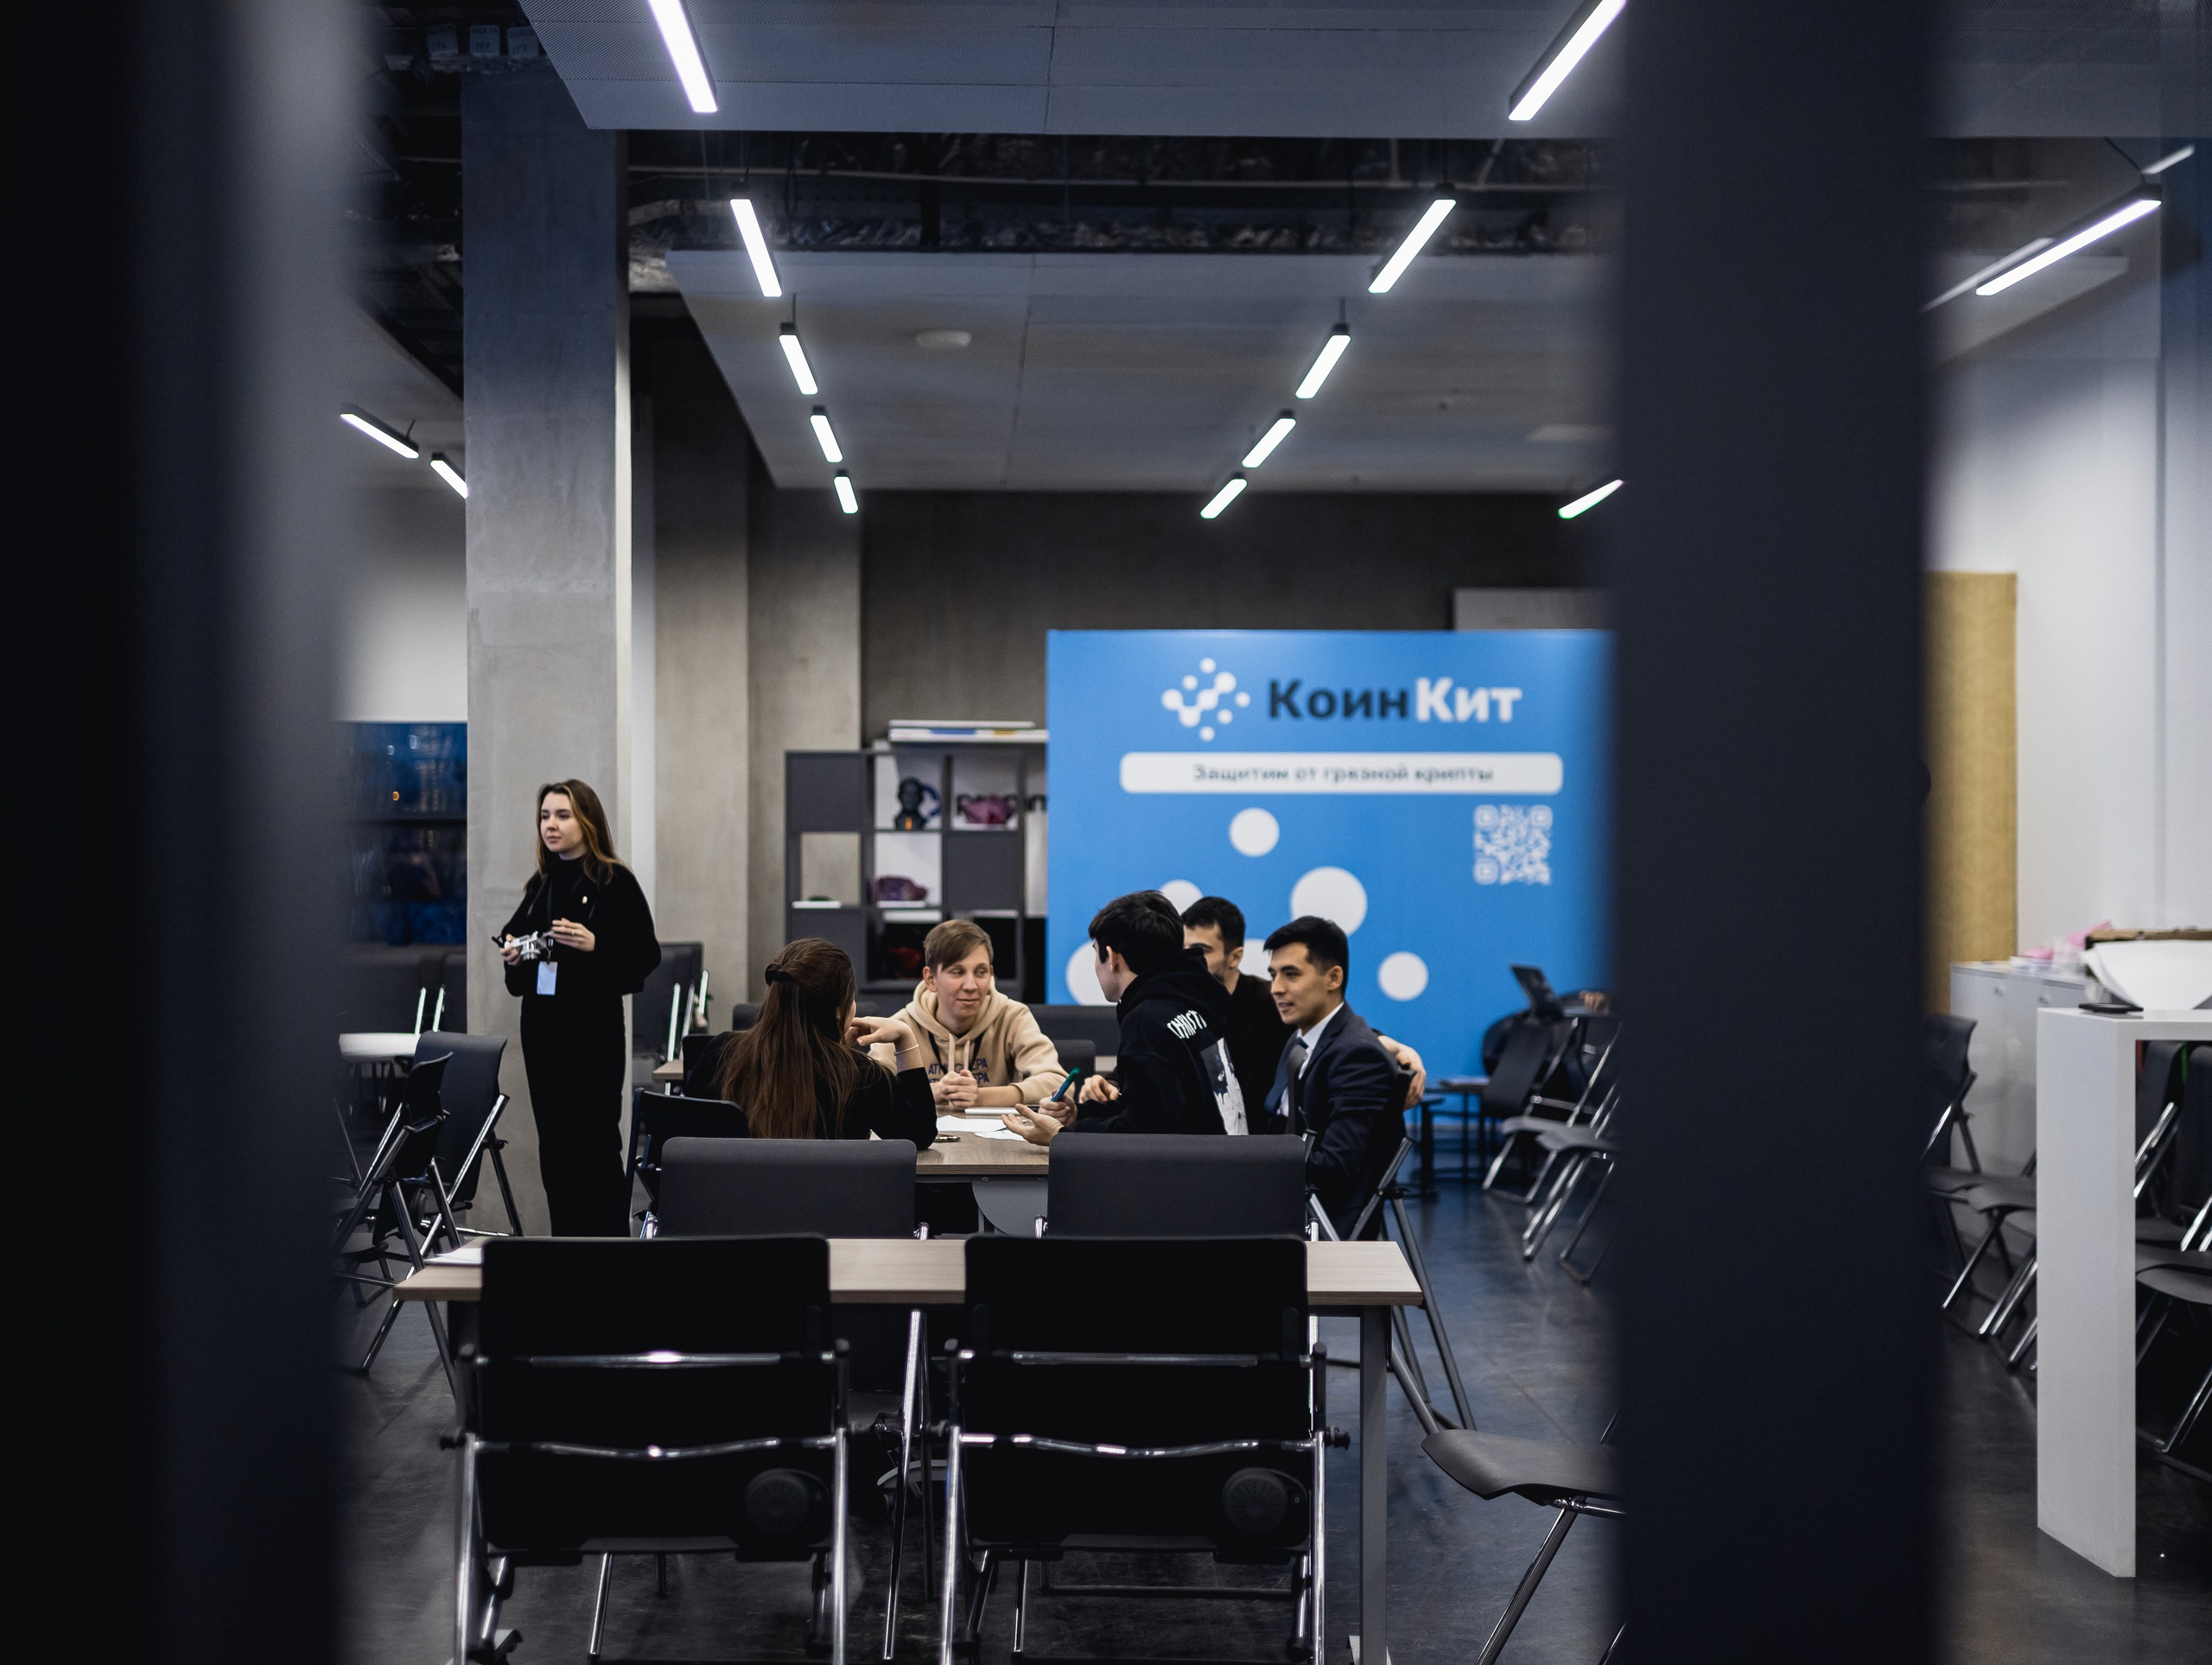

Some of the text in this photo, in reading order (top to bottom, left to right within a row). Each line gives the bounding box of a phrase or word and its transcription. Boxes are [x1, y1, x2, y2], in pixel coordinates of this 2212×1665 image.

[1193, 763, 1494, 785] Защитим от грязной крипты
